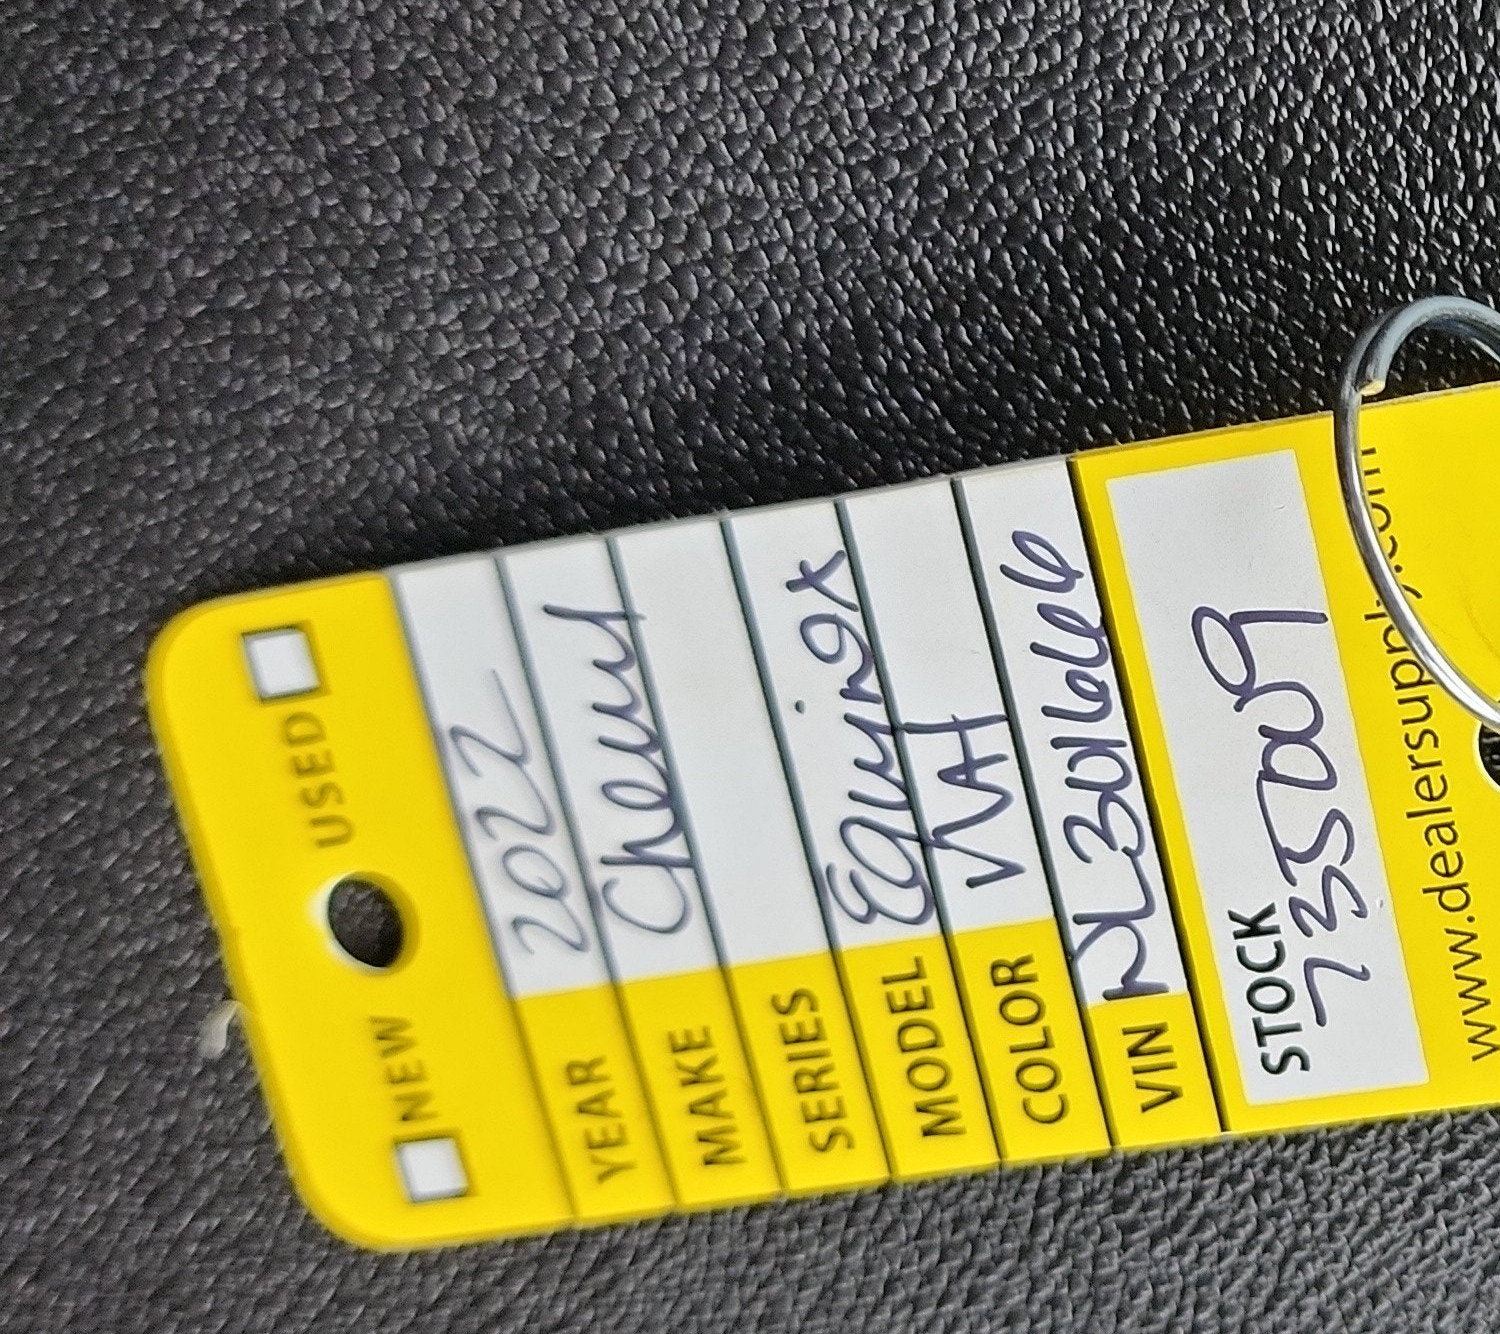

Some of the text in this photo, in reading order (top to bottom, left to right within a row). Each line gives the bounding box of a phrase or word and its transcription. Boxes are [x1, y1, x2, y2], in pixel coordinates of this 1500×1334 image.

[286, 710, 357, 849] USED
[449, 667, 592, 957] 2022
[785, 548, 940, 928] Equinox
[369, 1015, 435, 1124] NEW
[770, 985, 855, 1155] SERIES
[880, 953, 962, 1140] MODEL
[998, 952, 1070, 1127] COLOR
[1122, 1019, 1187, 1115] VIN
[1233, 901, 1312, 1079] STOCK
[566, 1054, 639, 1187] YEAR
[669, 1024, 744, 1168] MAKE
